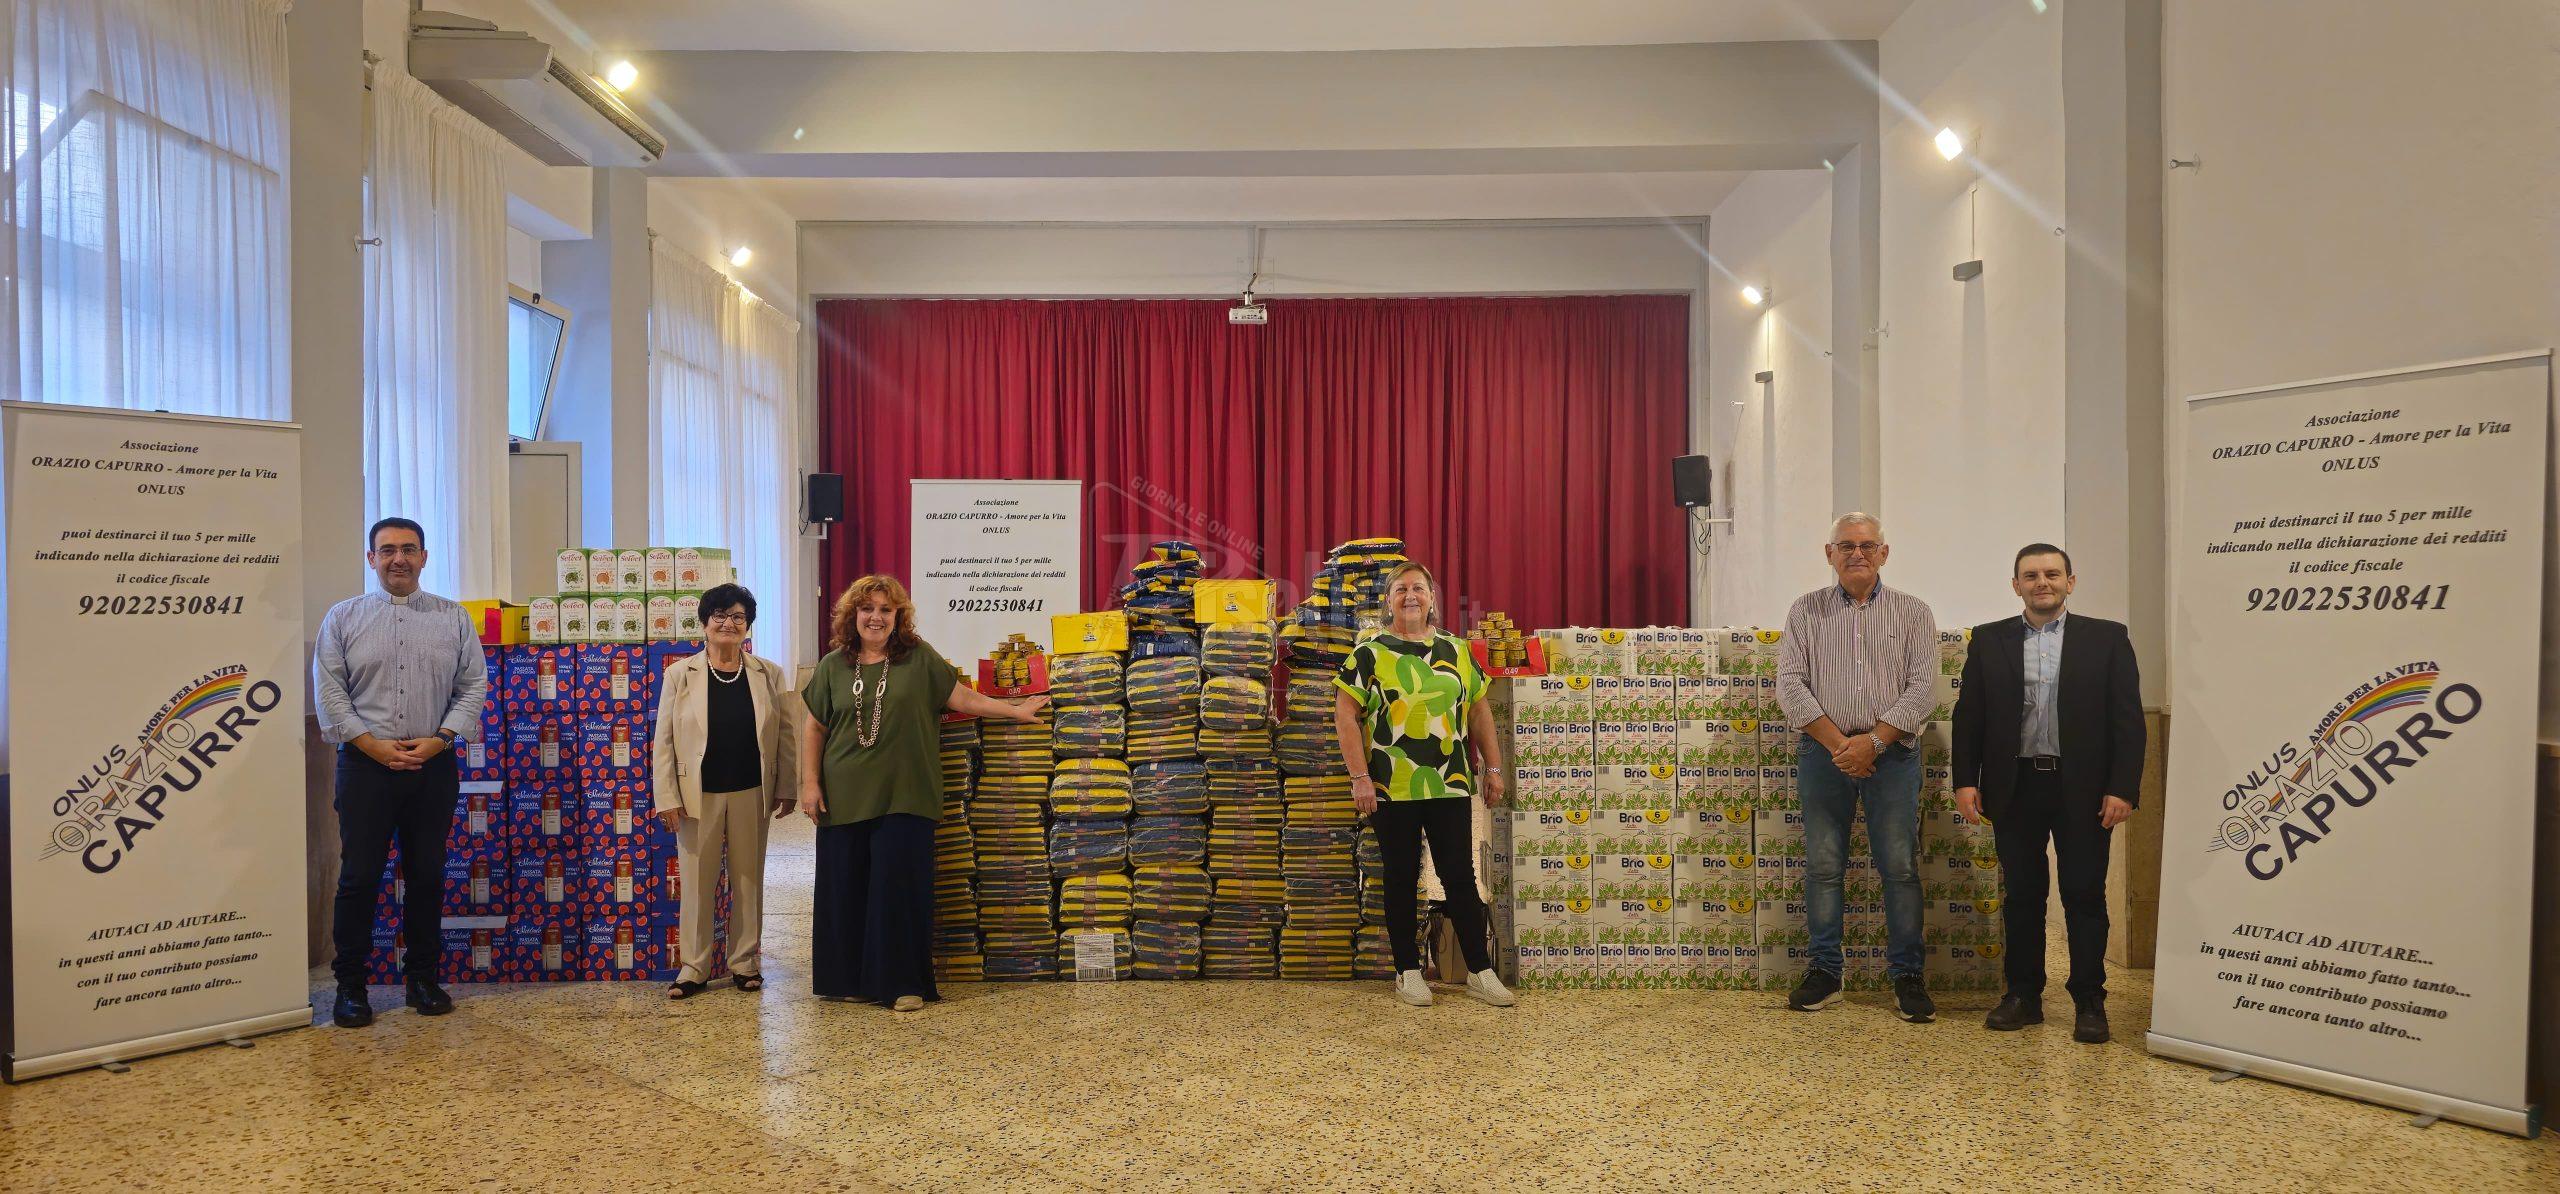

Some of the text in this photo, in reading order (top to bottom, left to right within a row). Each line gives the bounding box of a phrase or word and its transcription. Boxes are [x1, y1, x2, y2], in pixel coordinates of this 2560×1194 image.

[2304, 409, 2400, 427] Associazione
[120, 440, 199, 453] Associazione
[2212, 443, 2271, 459] ORAZIO
[2276, 434, 2354, 453] CAPURRO
[2368, 432, 2420, 445] Amore
[2421, 429, 2452, 443] per
[2455, 425, 2471, 437] la
[2478, 421, 2511, 435] Vita
[32, 456, 90, 469] ORAZIO
[95, 460, 164, 472] CAPURRO
[175, 464, 215, 475] Amore
[216, 469, 237, 478] per
[240, 468, 251, 477] la
[256, 469, 277, 479] Vita
[2322, 456, 2380, 472] ONLUS
[137, 484, 185, 495] ONLUS
[973, 499, 1019, 507] Associazione
[959, 512, 999, 520] CAPURRO
[2233, 506, 2472, 533] puoi destinarci il tuo 5 per mille
[61, 529, 256, 544] puoi destinarci il tuo 5 per mille
[983, 526, 1010, 534] ONLUS
[2207, 529, 2507, 554] indicando nella dichiarazione dei redditi
[35, 550, 279, 564] indicando nella dichiarazione dei redditi
[940, 557, 957, 565] puoi
[2289, 558, 2403, 575] il codice fiscale
[116, 573, 210, 586] il codice fiscale
[981, 570, 1029, 579] dichiarazione
[1031, 570, 1042, 578] dei
[1043, 570, 1066, 578] redditi
[998, 584, 1023, 593] fiscale
[78, 595, 244, 615] 92022530841
[2246, 584, 2450, 611] 92022530841
[948, 599, 1043, 612] 92022530841
[1576, 633, 1598, 644] Brio
[1657, 632, 1678, 642] Brio
[1682, 633, 1703, 642] Brio
[1541, 680, 1563, 690] Brio
[1596, 678, 1618, 688] Brio
[1706, 678, 1728, 687] Brio
[137, 663, 248, 744] AMORE PER LA VITA
[2308, 661, 2441, 745] AMORE PER LA VITA
[1516, 725, 1538, 735] Brio
[53, 744, 126, 817] ONLUS
[81, 679, 282, 874] CAPURRO
[2222, 741, 2298, 811] ONLUS
[2244, 682, 2482, 881] CAPURRO
[52, 717, 196, 853] ORAZIO
[2219, 719, 2373, 852] ORAZIO
[1621, 857, 1644, 868] Brio
[1703, 857, 1726, 868] Brio
[1949, 858, 1971, 868] Brio
[1949, 903, 1972, 913] Brio
[87, 911, 246, 941] AIUTACI AD AIUTARE...
[59, 931, 272, 968] in questi anni abbiamo fatto tanto...
[1521, 947, 1542, 956] Brio
[1601, 946, 1622, 956] Brio
[2232, 924, 2433, 965] AIUTACI AD AIUTARE...
[1952, 948, 1974, 958] Brio
[77, 953, 258, 988] con il tuo contributo possiamo
[2200, 942, 2471, 997] in questi anni abbiamo fatto tanto...
[93, 978, 242, 1011] fare ancora tanto altro...
[2218, 972, 2448, 1019] con il tuo contributo possiamo
[2233, 994, 2421, 1041] fare ancora tanto altro...
